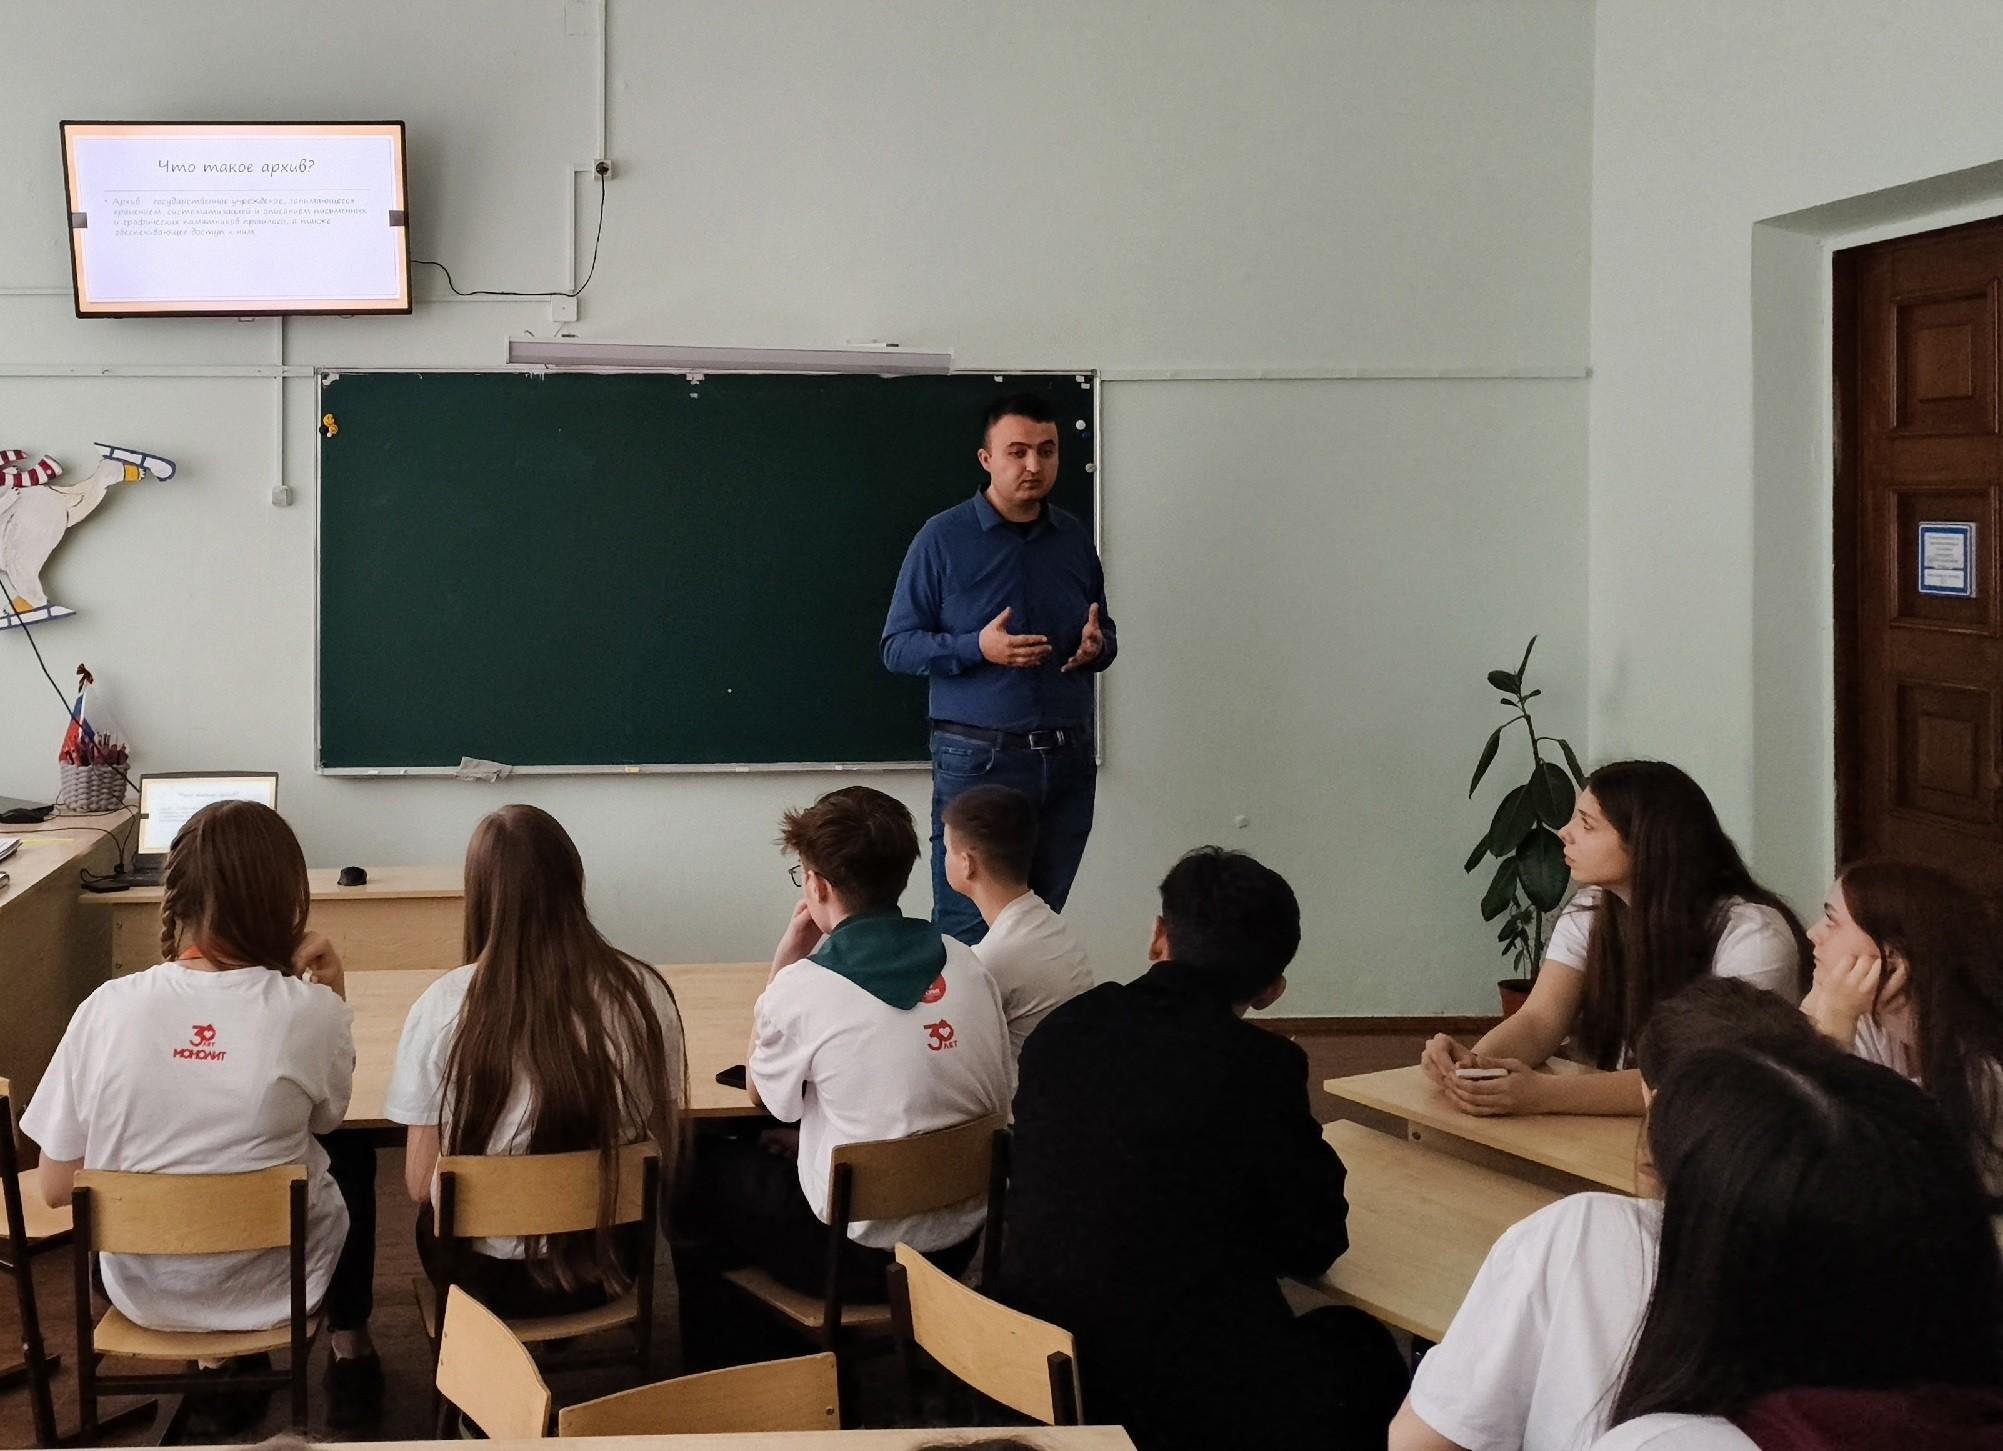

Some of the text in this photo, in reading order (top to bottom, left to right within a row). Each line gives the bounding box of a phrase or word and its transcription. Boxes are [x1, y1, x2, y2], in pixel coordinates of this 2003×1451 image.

[158, 158, 315, 178] Что такое архив?
[173, 1048, 227, 1061] МОНОЛИТ
